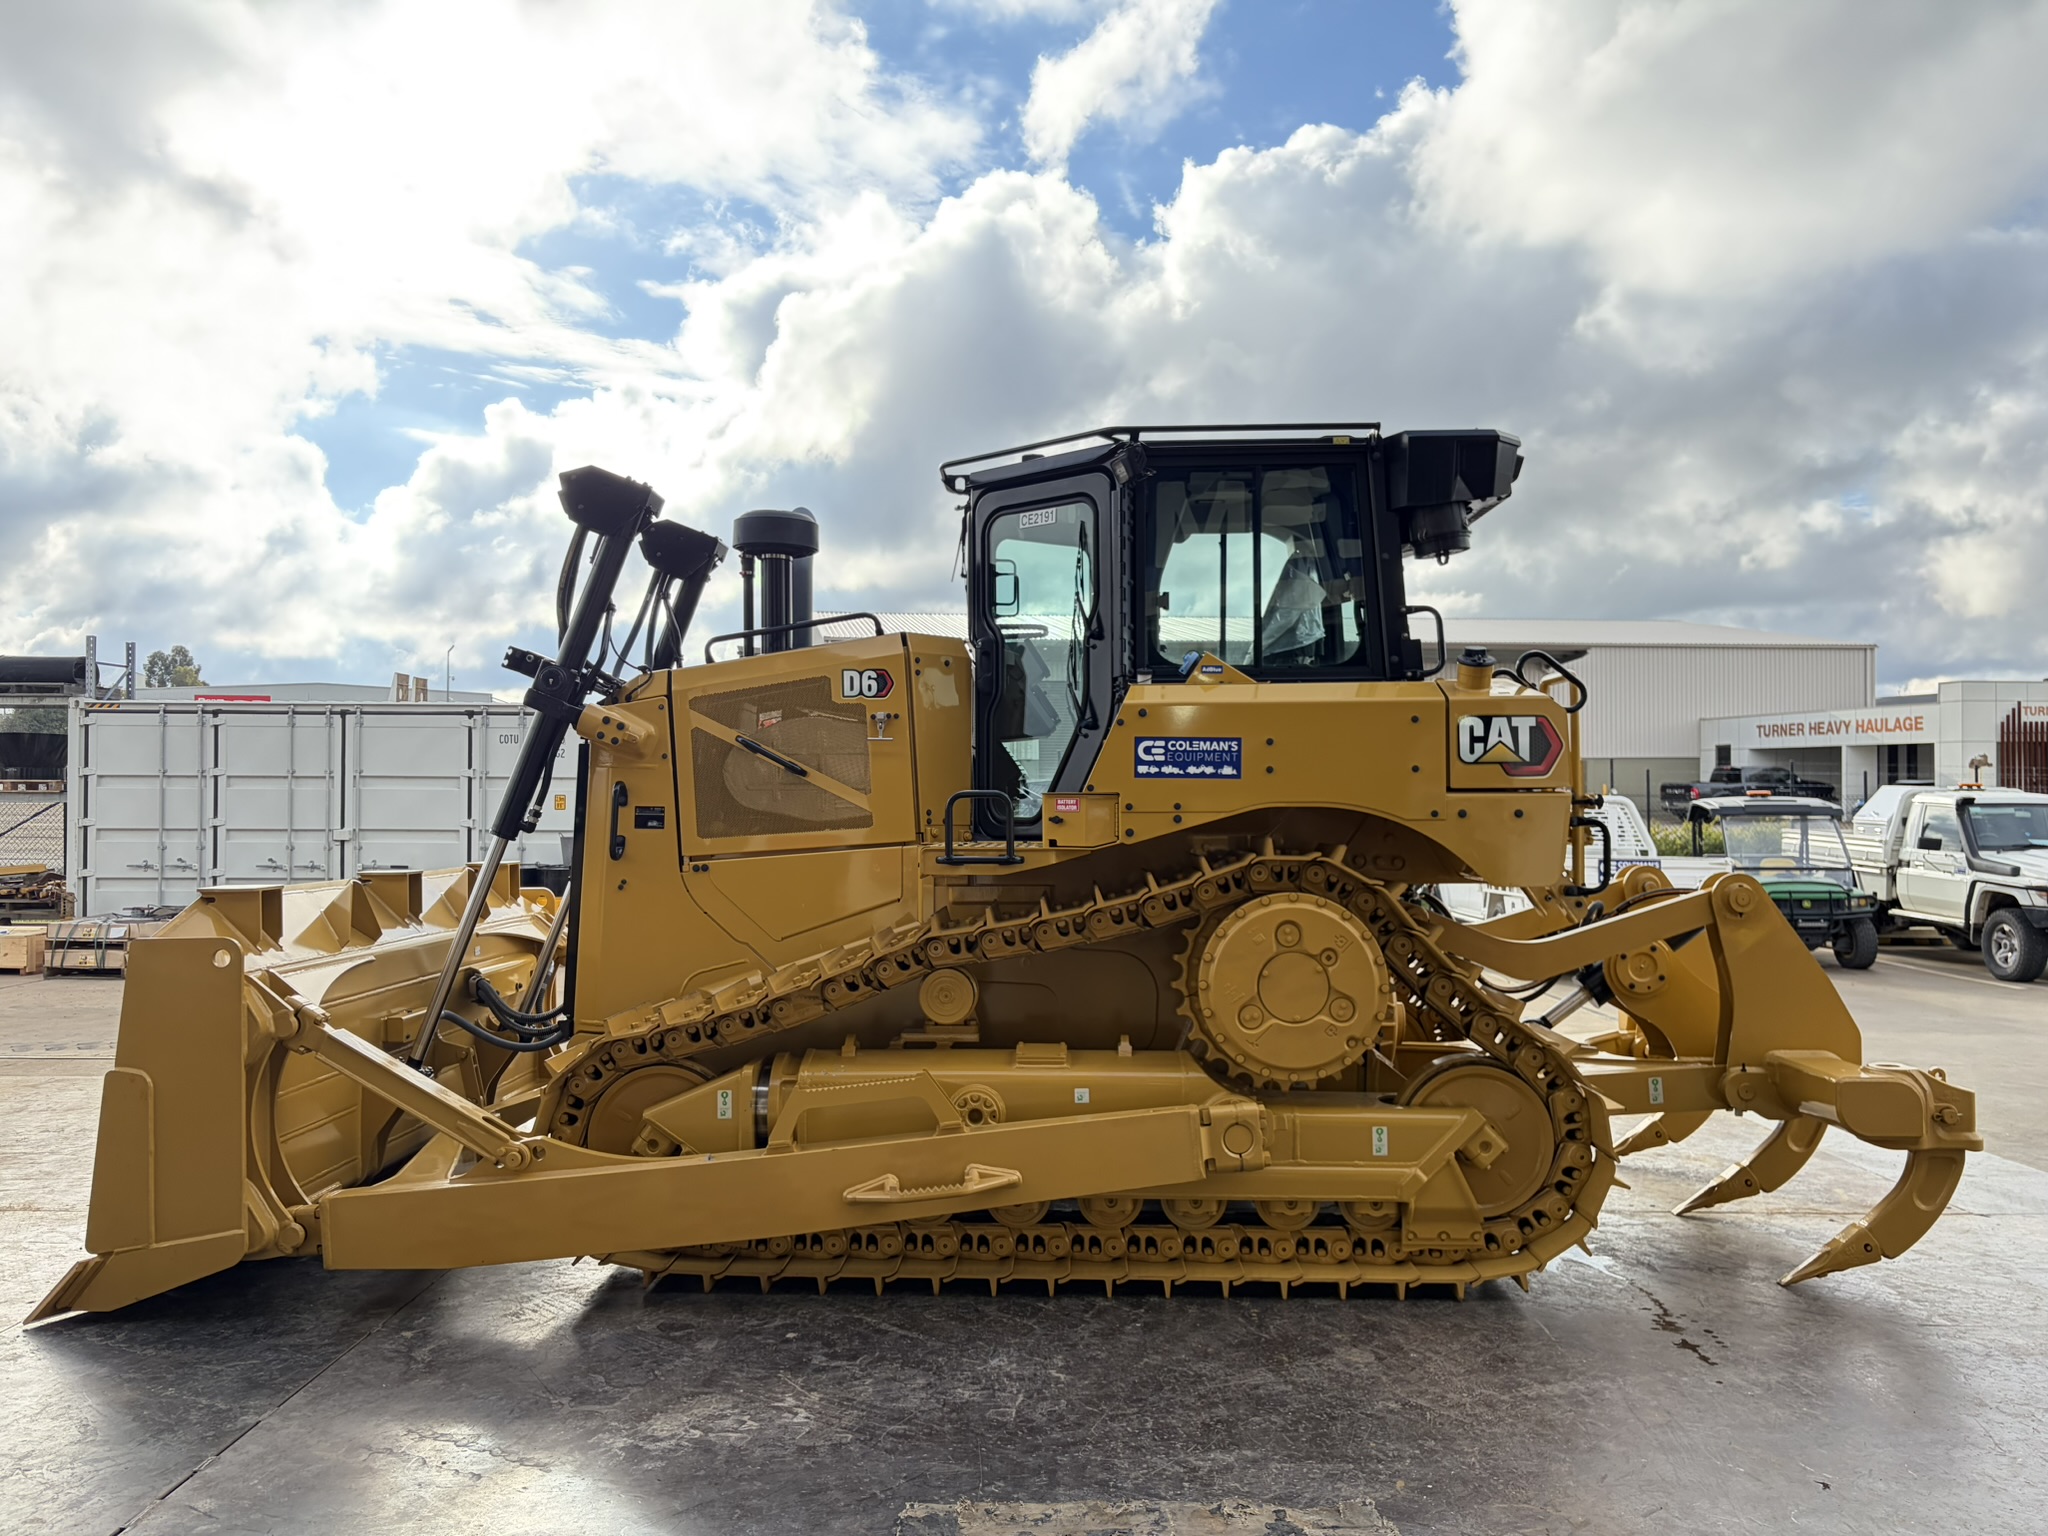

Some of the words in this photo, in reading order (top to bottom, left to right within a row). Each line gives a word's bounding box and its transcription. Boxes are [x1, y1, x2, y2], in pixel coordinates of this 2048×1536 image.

[1021, 510, 1054, 526] CE2191
[843, 670, 878, 697] D6
[2022, 705, 2048, 716] TUR
[1756, 723, 1805, 738] TURNER
[1808, 720, 1851, 736] HEAVY
[1856, 716, 1924, 733] HAULAGE
[499, 734, 519, 744] COTU
[1167, 740, 1239, 751] COLEMAN'S
[1459, 716, 1536, 763] CAT
[1167, 752, 1239, 762] EQUIPMENT
